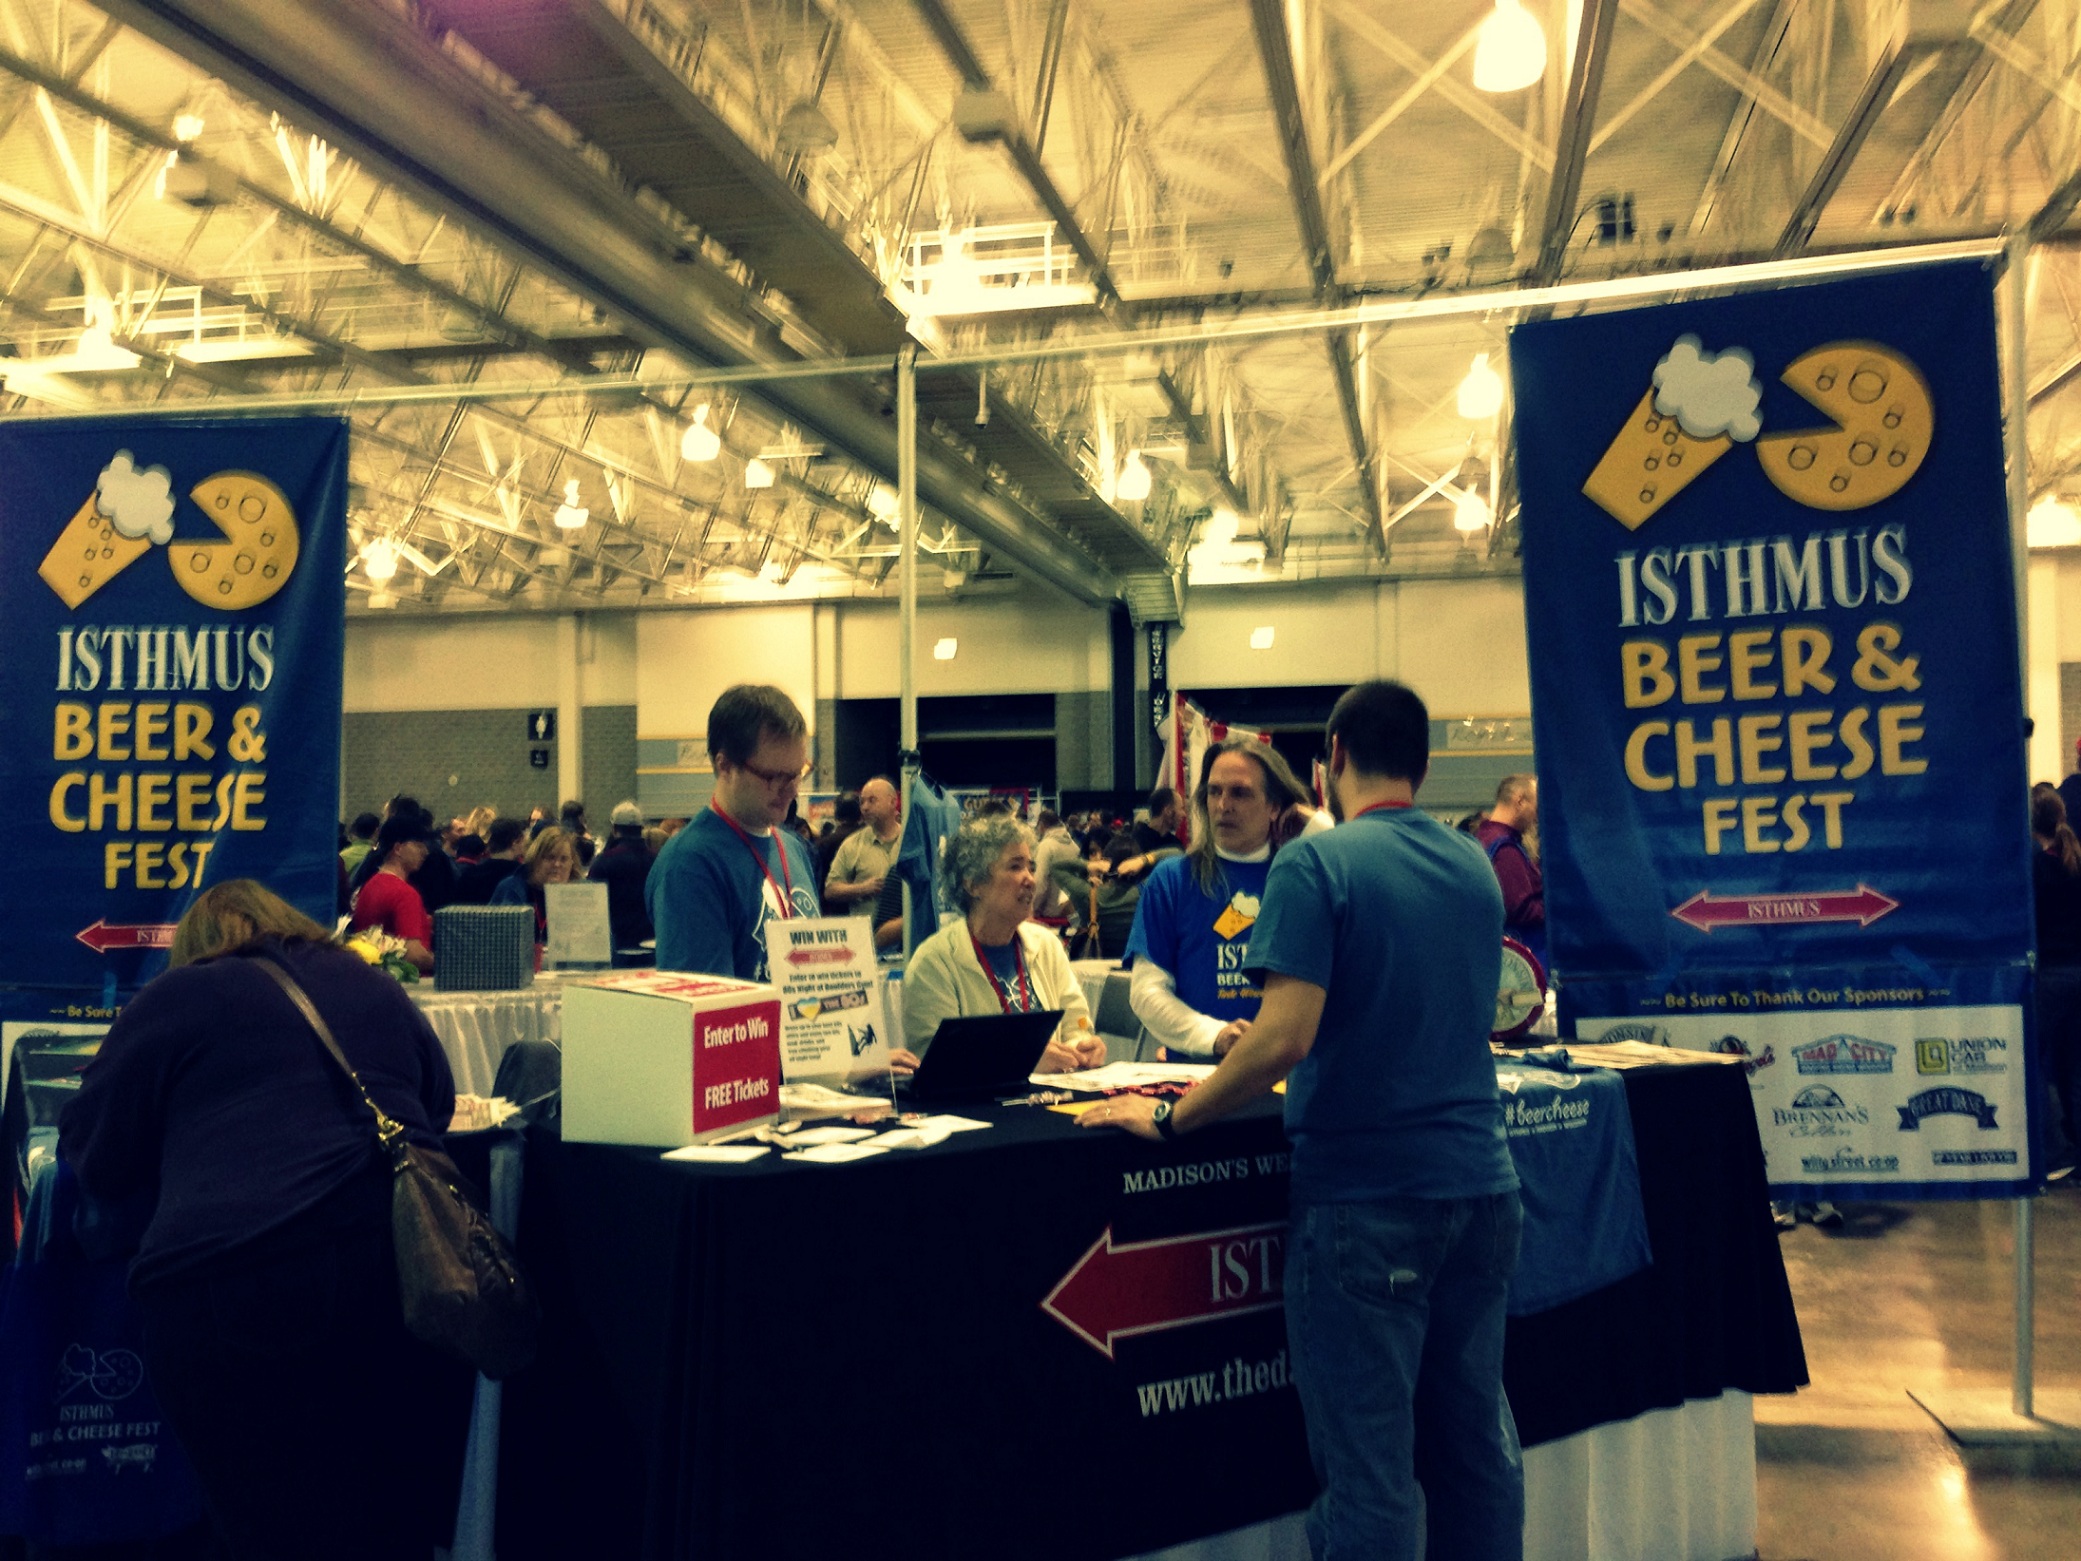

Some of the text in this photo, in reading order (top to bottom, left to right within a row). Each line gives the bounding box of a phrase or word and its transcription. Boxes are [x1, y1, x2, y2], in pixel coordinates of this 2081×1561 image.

[1614, 523, 1913, 627] ISTHMUS
[55, 625, 275, 692] ISTHMUS
[1620, 624, 1922, 709] BEER &
[53, 703, 267, 762] BEER &
[1624, 705, 1930, 792] CHEESE
[49, 773, 268, 832] CHEESE
[1702, 791, 1854, 856] FEST
[104, 841, 213, 889] FEST
[1747, 901, 1821, 919] ISTHMUS
[789, 930, 847, 945] WIN WITH
[67, 1005, 82, 1017] Be
[85, 1005, 113, 1018] Sure
[1665, 986, 1925, 1008] Be Sure To Thank Our Sponsors
[704, 1016, 768, 1049] Enter to Win
[1949, 1038, 2007, 1052] UNION
[705, 1077, 769, 1110] FREE Tickets
[1505, 1094, 1589, 1127] #beercheese
[1123, 1157, 1249, 1194] MADISON'S
[1209, 1236, 1280, 1303] IST
[1137, 1352, 1292, 1417] www.thed
[68, 1424, 122, 1441] CHEESE
[126, 1422, 161, 1438] FEST
